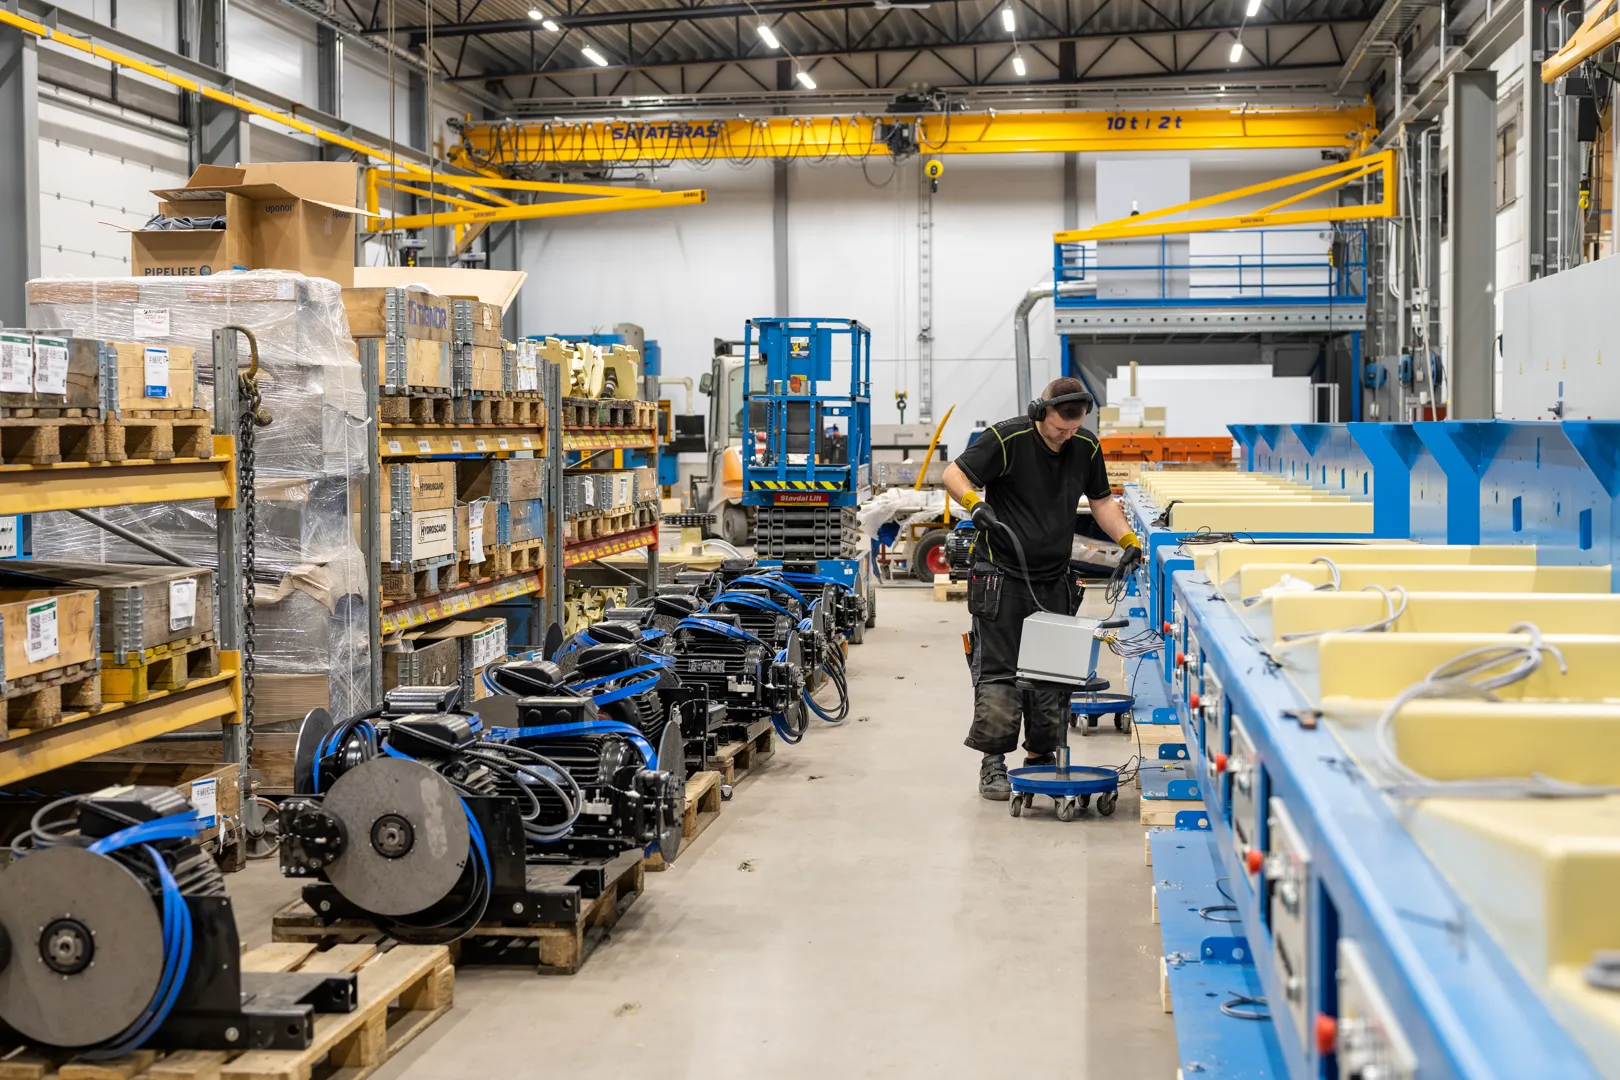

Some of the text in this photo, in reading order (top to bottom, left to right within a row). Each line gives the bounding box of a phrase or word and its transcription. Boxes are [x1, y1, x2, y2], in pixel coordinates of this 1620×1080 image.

[1107, 116, 1126, 130] 10
[1130, 116, 1138, 130] t
[1158, 116, 1171, 129] 2
[1175, 116, 1182, 129] t
[612, 124, 719, 140] SATATERAS
[265, 204, 293, 213] uponor
[144, 267, 196, 276] PIPELIFE
[420, 482, 444, 492] HYDROSCAND
[780, 494, 823, 502] Stavdal Lift
[420, 523, 447, 536] HYDROSCAND
[384, 579, 400, 590] EUR
